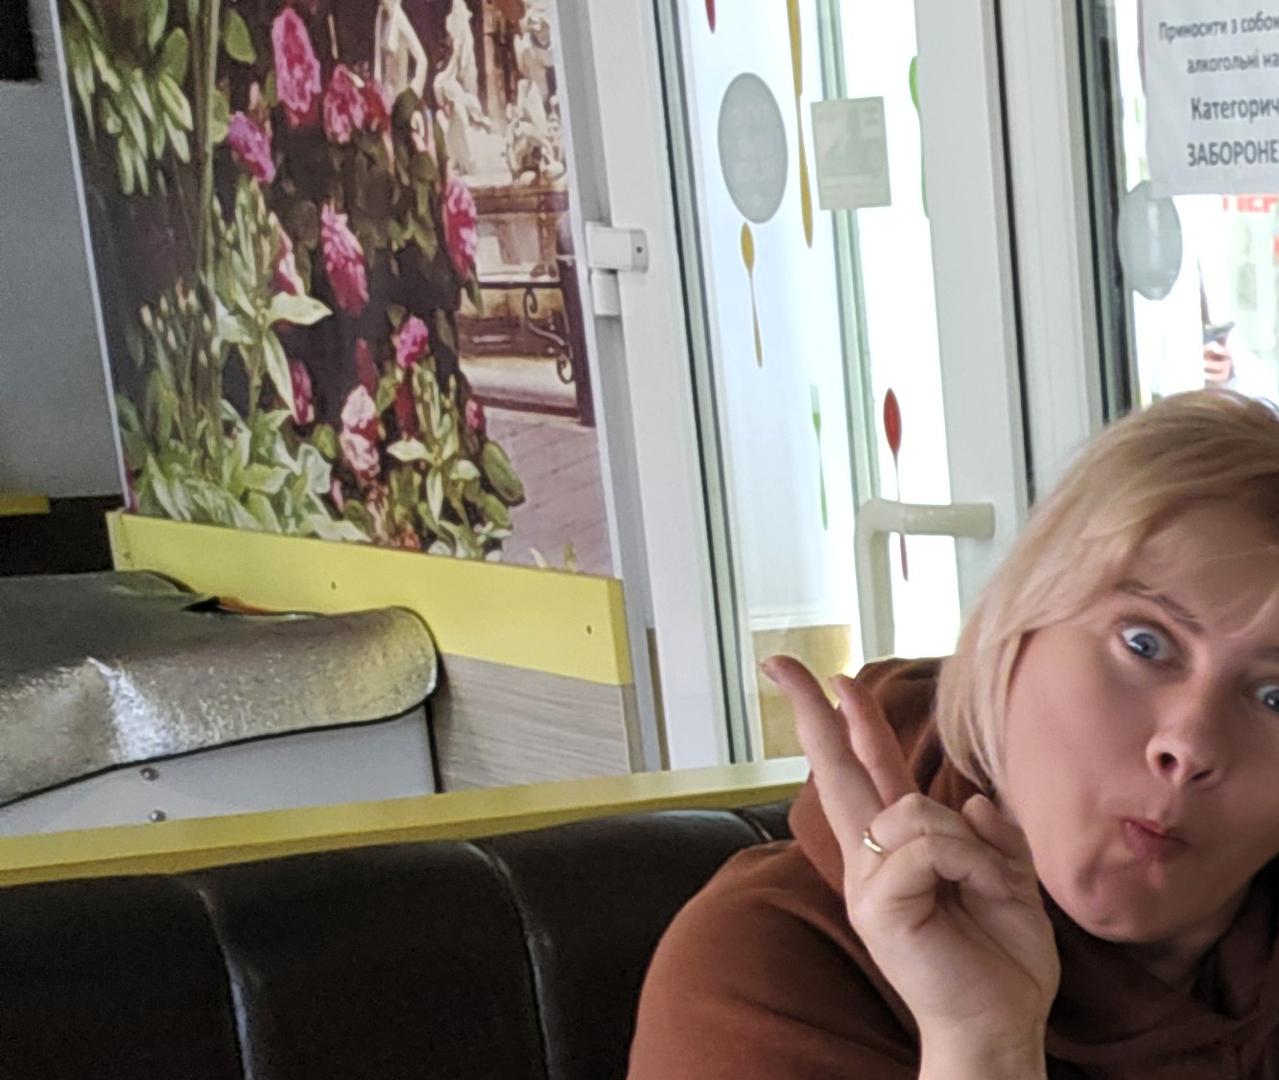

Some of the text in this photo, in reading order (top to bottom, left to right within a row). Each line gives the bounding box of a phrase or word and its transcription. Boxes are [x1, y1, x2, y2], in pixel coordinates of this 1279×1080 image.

[1158, 20, 1228, 44] Приносити
[1231, 18, 1238, 34] з
[1186, 48, 1260, 74] алкогольні
